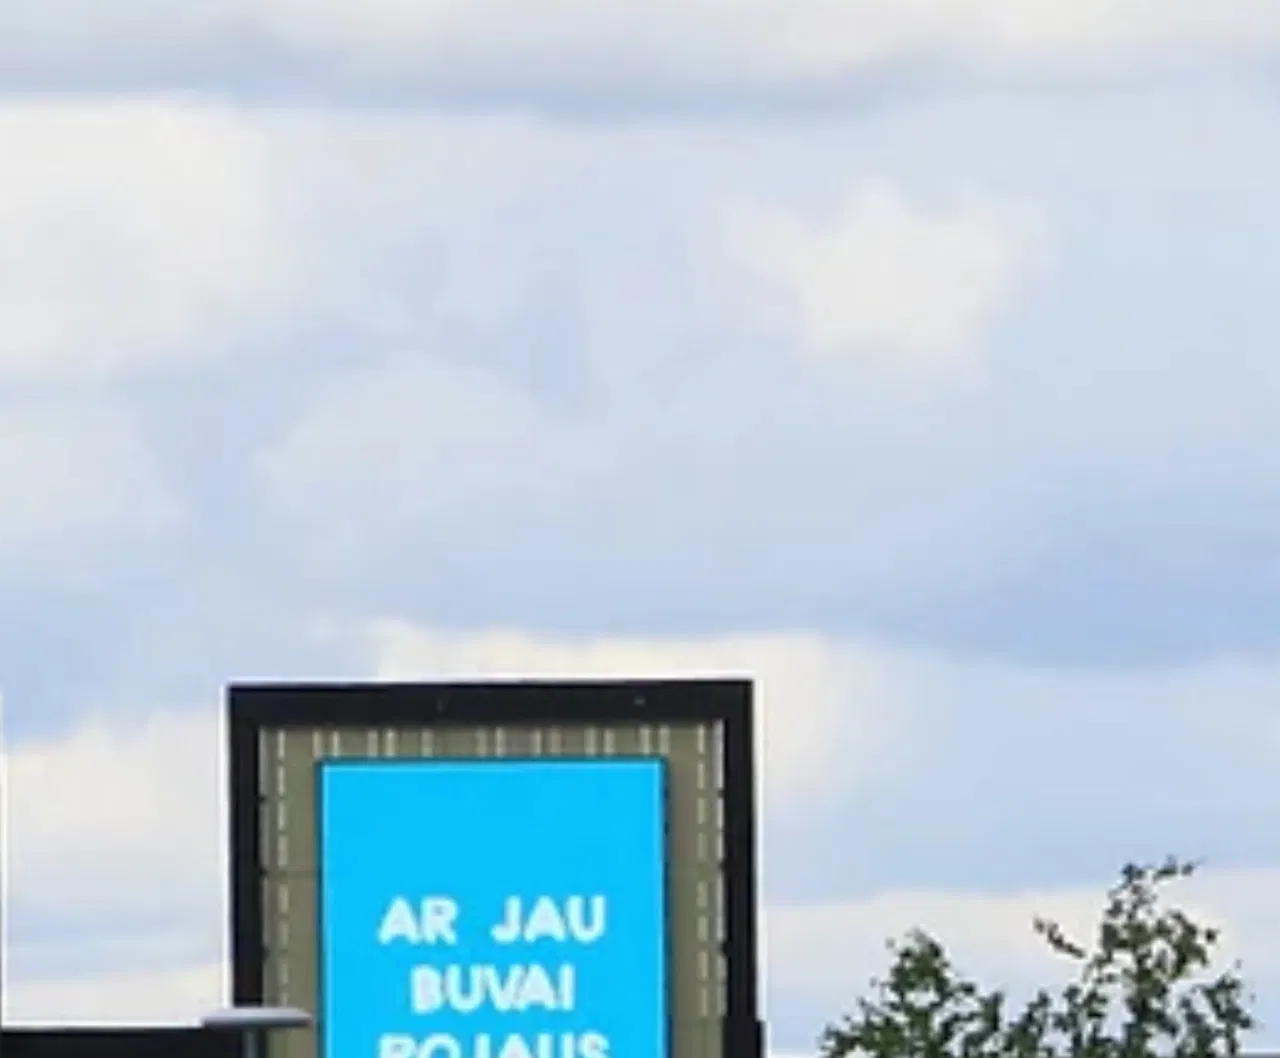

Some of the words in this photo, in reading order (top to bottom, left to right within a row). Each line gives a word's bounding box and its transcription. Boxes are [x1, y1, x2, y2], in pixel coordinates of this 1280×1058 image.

[378, 896, 459, 945] AR
[491, 895, 606, 944] JAU
[410, 963, 576, 1014] BUVAI
